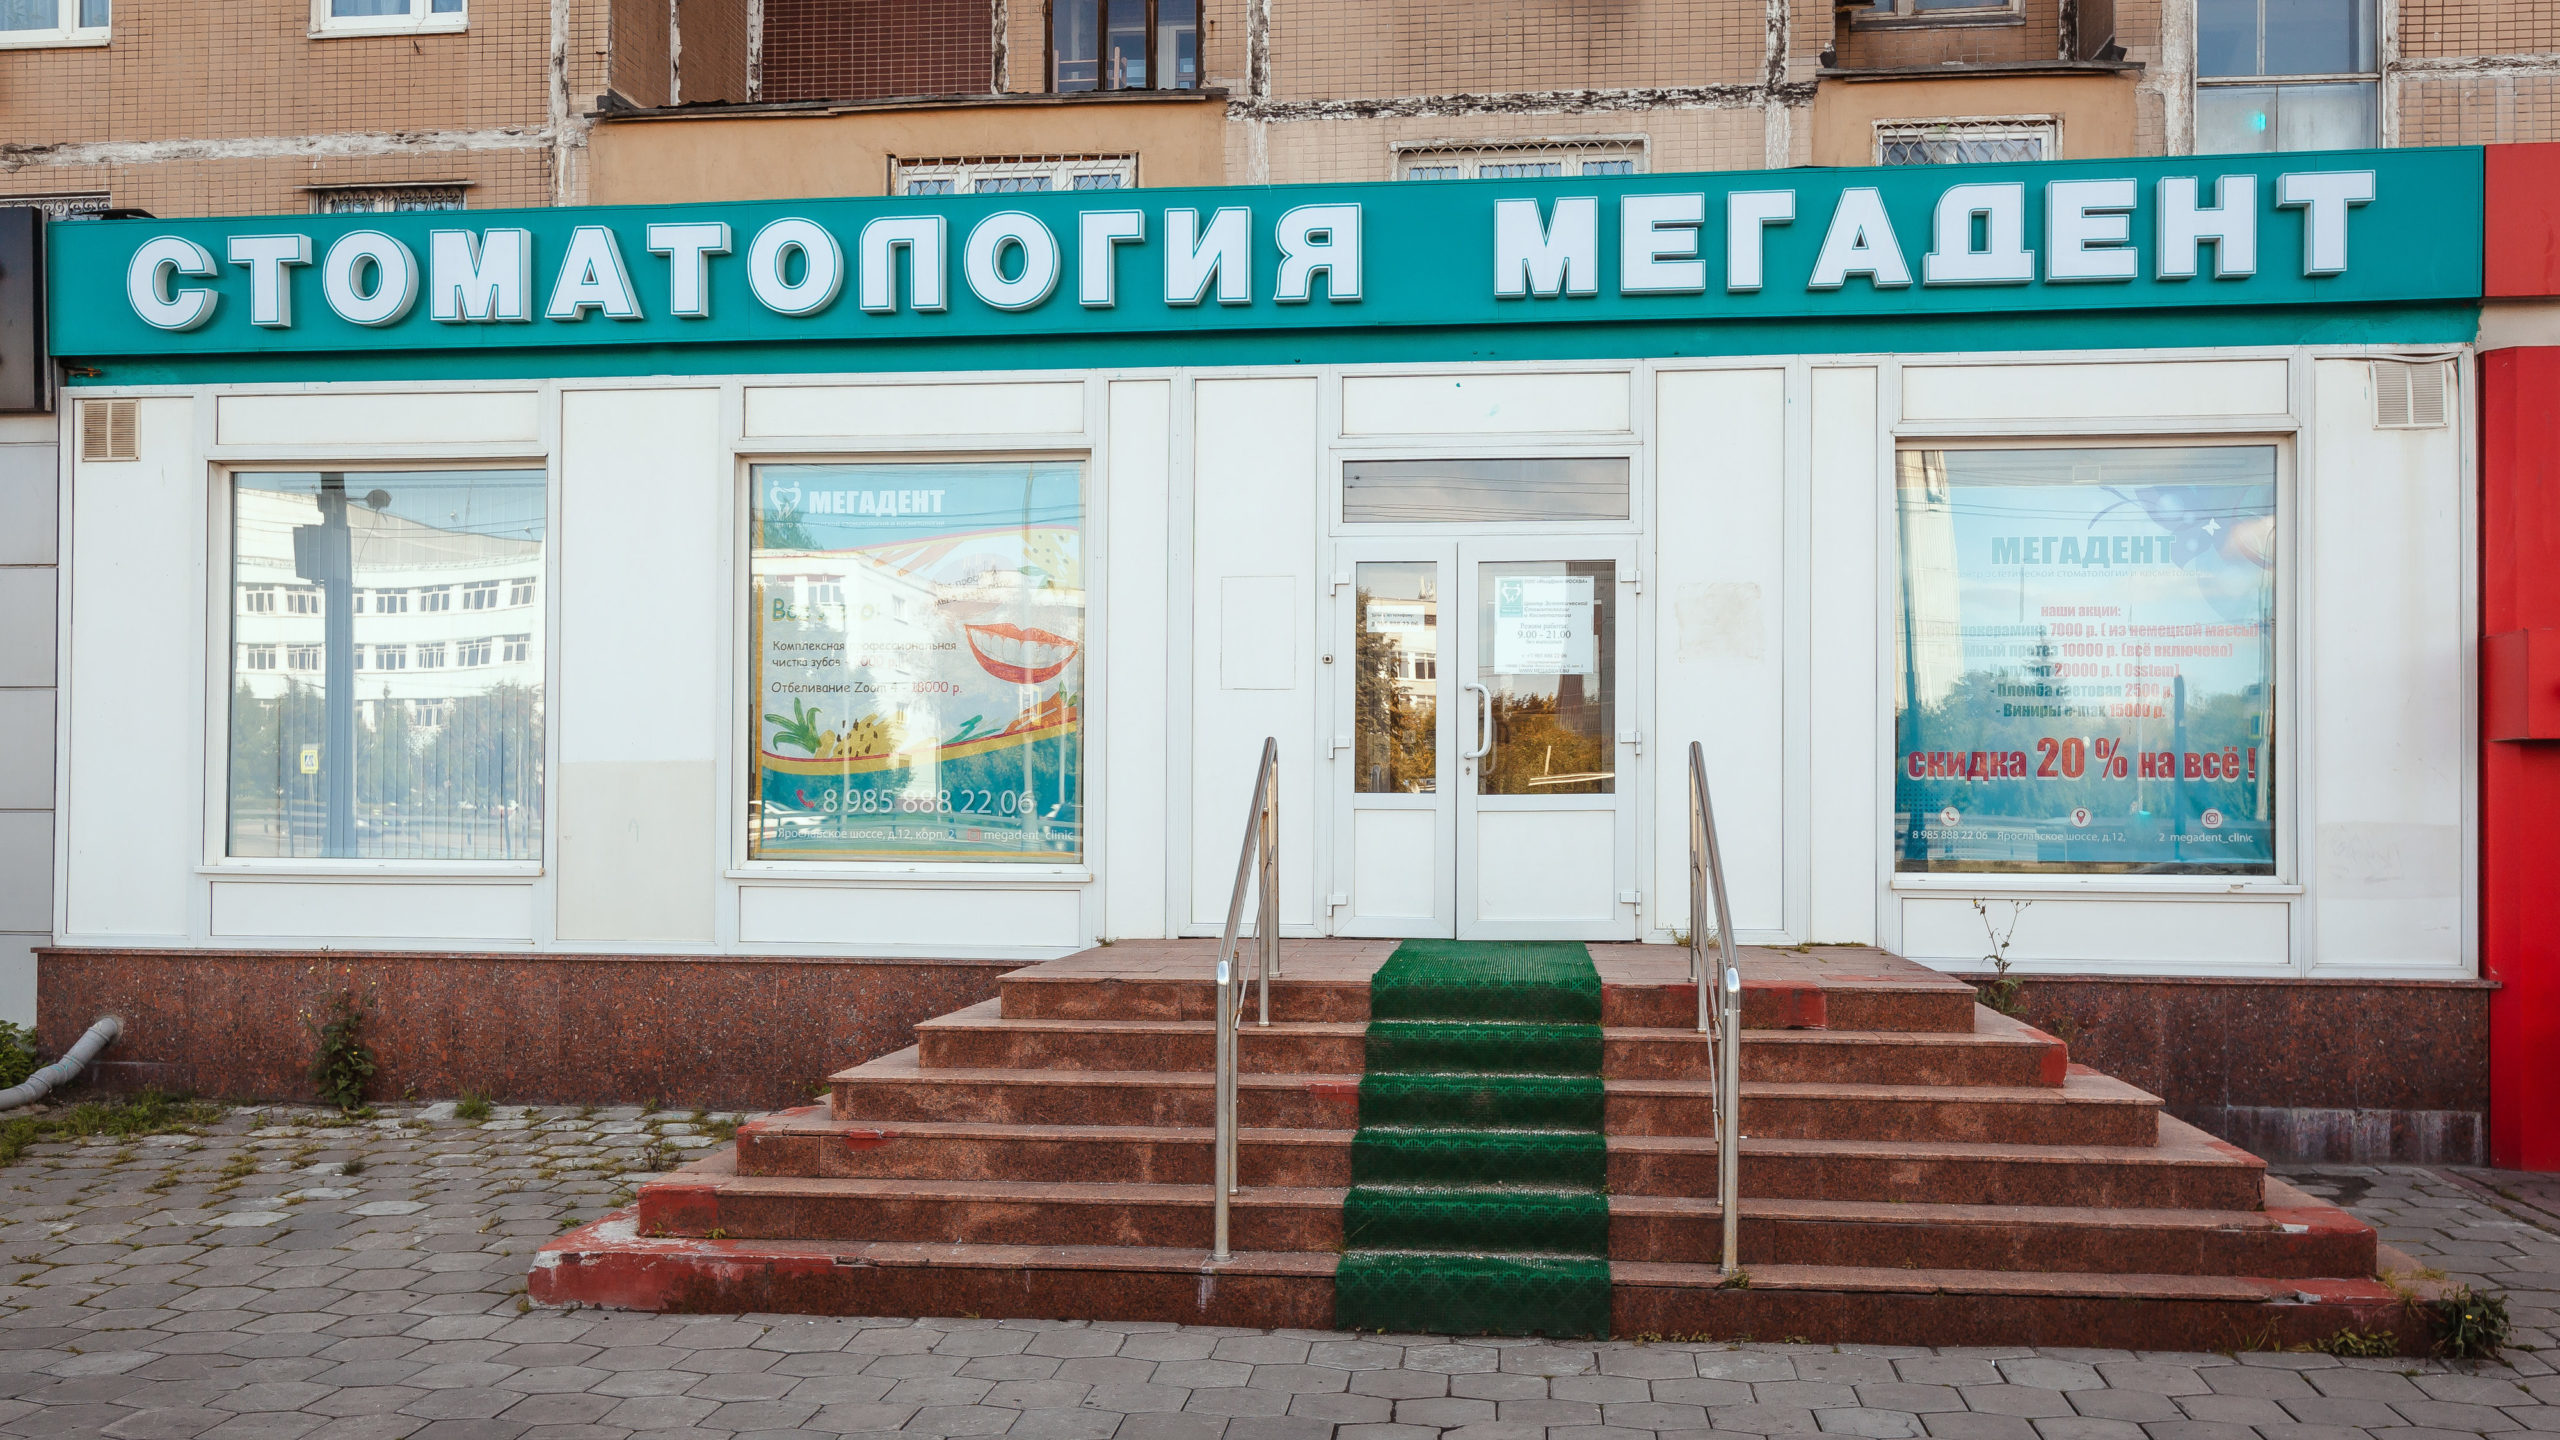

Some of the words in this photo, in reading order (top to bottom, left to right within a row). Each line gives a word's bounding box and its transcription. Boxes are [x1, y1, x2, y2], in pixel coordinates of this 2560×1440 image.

[127, 203, 1363, 332] СТОМАТОЛОГИЯ
[1494, 169, 2377, 299] МЕГАДЕНТ
[808, 489, 946, 517] МЕГАДЕНТ
[1990, 535, 2176, 569] МЕГАДЕНТ
[2040, 605, 2075, 617] наши
[2078, 604, 2121, 619] акции:
[1517, 630, 1537, 639] 9.00
[1546, 630, 1571, 639] 21.00
[2050, 623, 2082, 637] 7000
[2129, 622, 2201, 639] немецкой
[772, 640, 845, 652] Комплексная
[2062, 642, 2104, 657] 10000
[771, 658, 808, 668] чистка
[811, 656, 841, 670] зубов
[2054, 662, 2098, 677] 20000
[770, 681, 851, 694] Отбеливание
[854, 681, 888, 694] Zoom
[1997, 683, 2053, 697] Пломба
[2125, 682, 2159, 697] 2500
[2003, 702, 2061, 719] Виниры
[2110, 703, 2151, 718] 15000
[1907, 750, 2027, 785] скидка
[2036, 736, 2086, 781] 20
[2094, 736, 2129, 781] %
[2137, 751, 2176, 781] на
[2183, 746, 2241, 782] всё
[823, 789, 839, 814] 8
[846, 789, 894, 814] 985
[902, 789, 953, 814] 888
[960, 789, 992, 814] 22
[1000, 789, 1034, 814] 06
[777, 828, 848, 841] Ярославское
[850, 830, 886, 840] шоссе,
[984, 829, 1074, 842] megadent_clinic
[1912, 830, 1918, 839] 8
[1920, 830, 1938, 840] 985
[1941, 830, 1959, 840] 888
[1961, 830, 1973, 840] 22
[1975, 830, 1988, 840] 06
[1997, 831, 2063, 843] Ярославское
[2066, 832, 2100, 842] шоссе,
[2170, 832, 2254, 845] megadent_clinic
